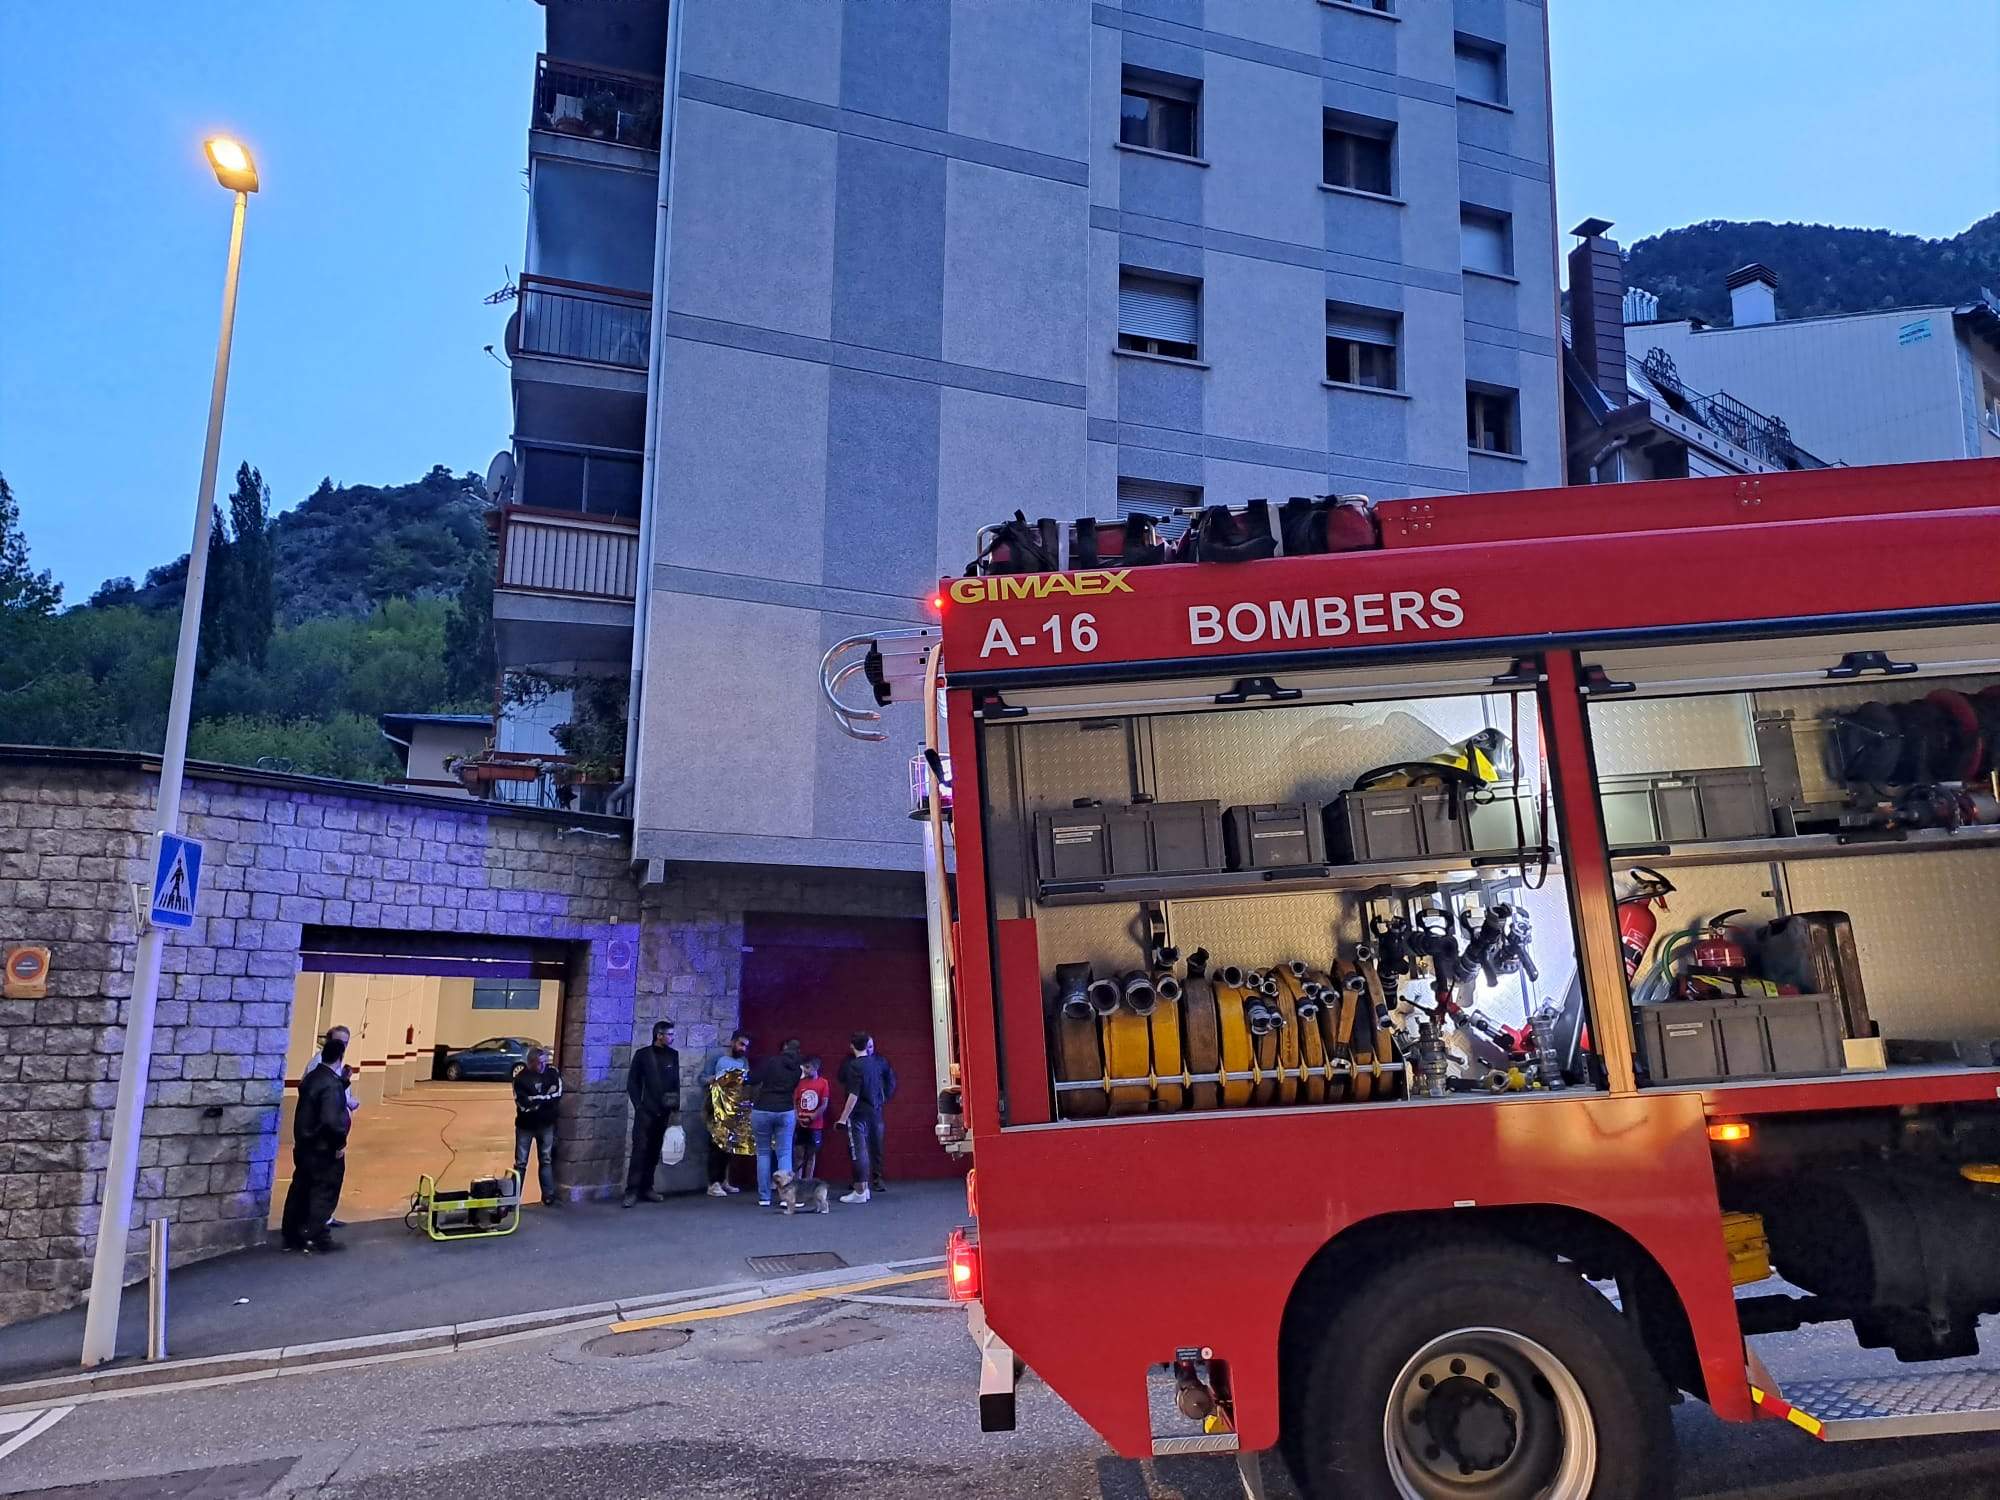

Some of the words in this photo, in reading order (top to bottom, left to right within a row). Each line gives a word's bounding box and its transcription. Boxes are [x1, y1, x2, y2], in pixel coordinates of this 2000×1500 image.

[950, 569, 1135, 604] GIMAEX
[979, 612, 1099, 658] A-16
[1189, 587, 1464, 645] BOMBERS
